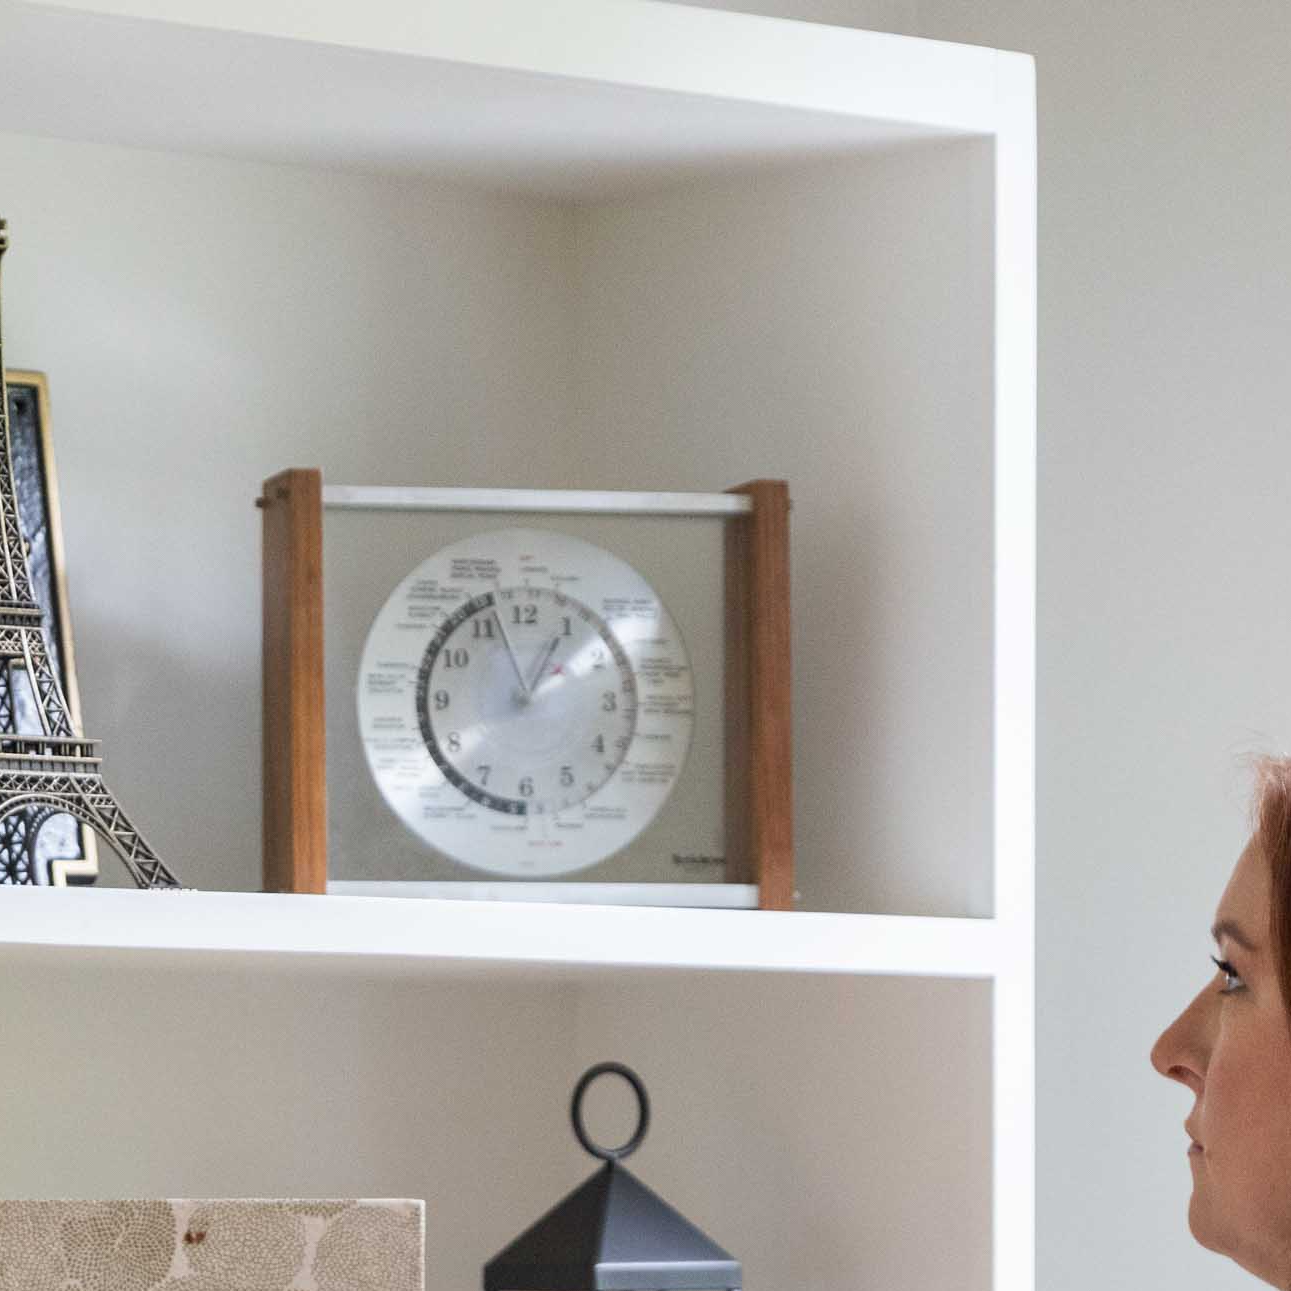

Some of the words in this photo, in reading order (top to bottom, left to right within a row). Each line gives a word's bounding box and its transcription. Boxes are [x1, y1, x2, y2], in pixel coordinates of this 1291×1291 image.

[512, 604, 538, 625] 12
[471, 619, 496, 639] 11
[561, 616, 573, 636] 1
[443, 648, 470, 668] 10
[435, 690, 450, 711] 9
[603, 691, 618, 713] 3
[447, 732, 461, 753] 8
[591, 733, 605, 753] 4
[477, 765, 491, 787] 7
[519, 776, 534, 797] 6
[560, 766, 574, 787] 5
